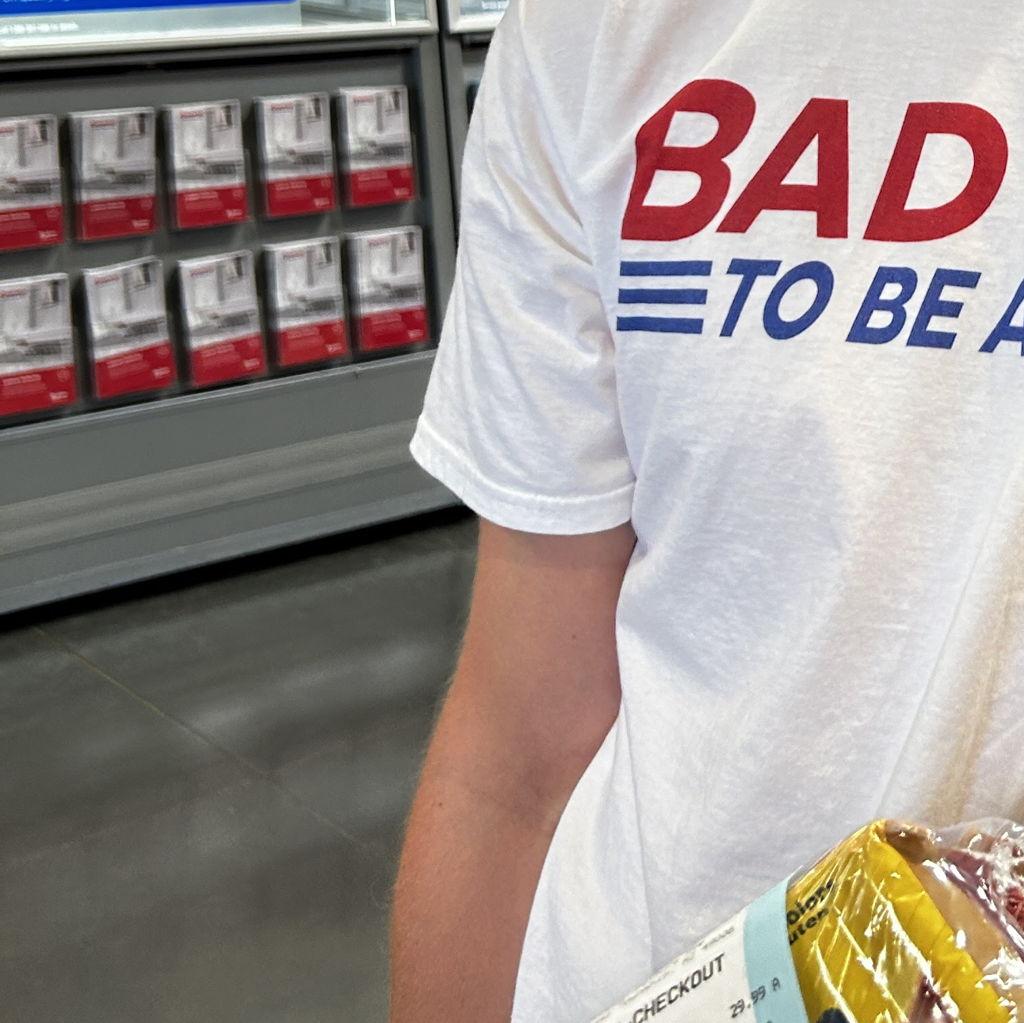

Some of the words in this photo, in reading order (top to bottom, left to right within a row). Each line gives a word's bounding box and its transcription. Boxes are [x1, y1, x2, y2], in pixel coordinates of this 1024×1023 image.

[620, 78, 1009, 243] BAD
[719, 258, 834, 340] TO
[845, 266, 982, 349] BE
[632, 952, 726, 1023] CHECKOUT
